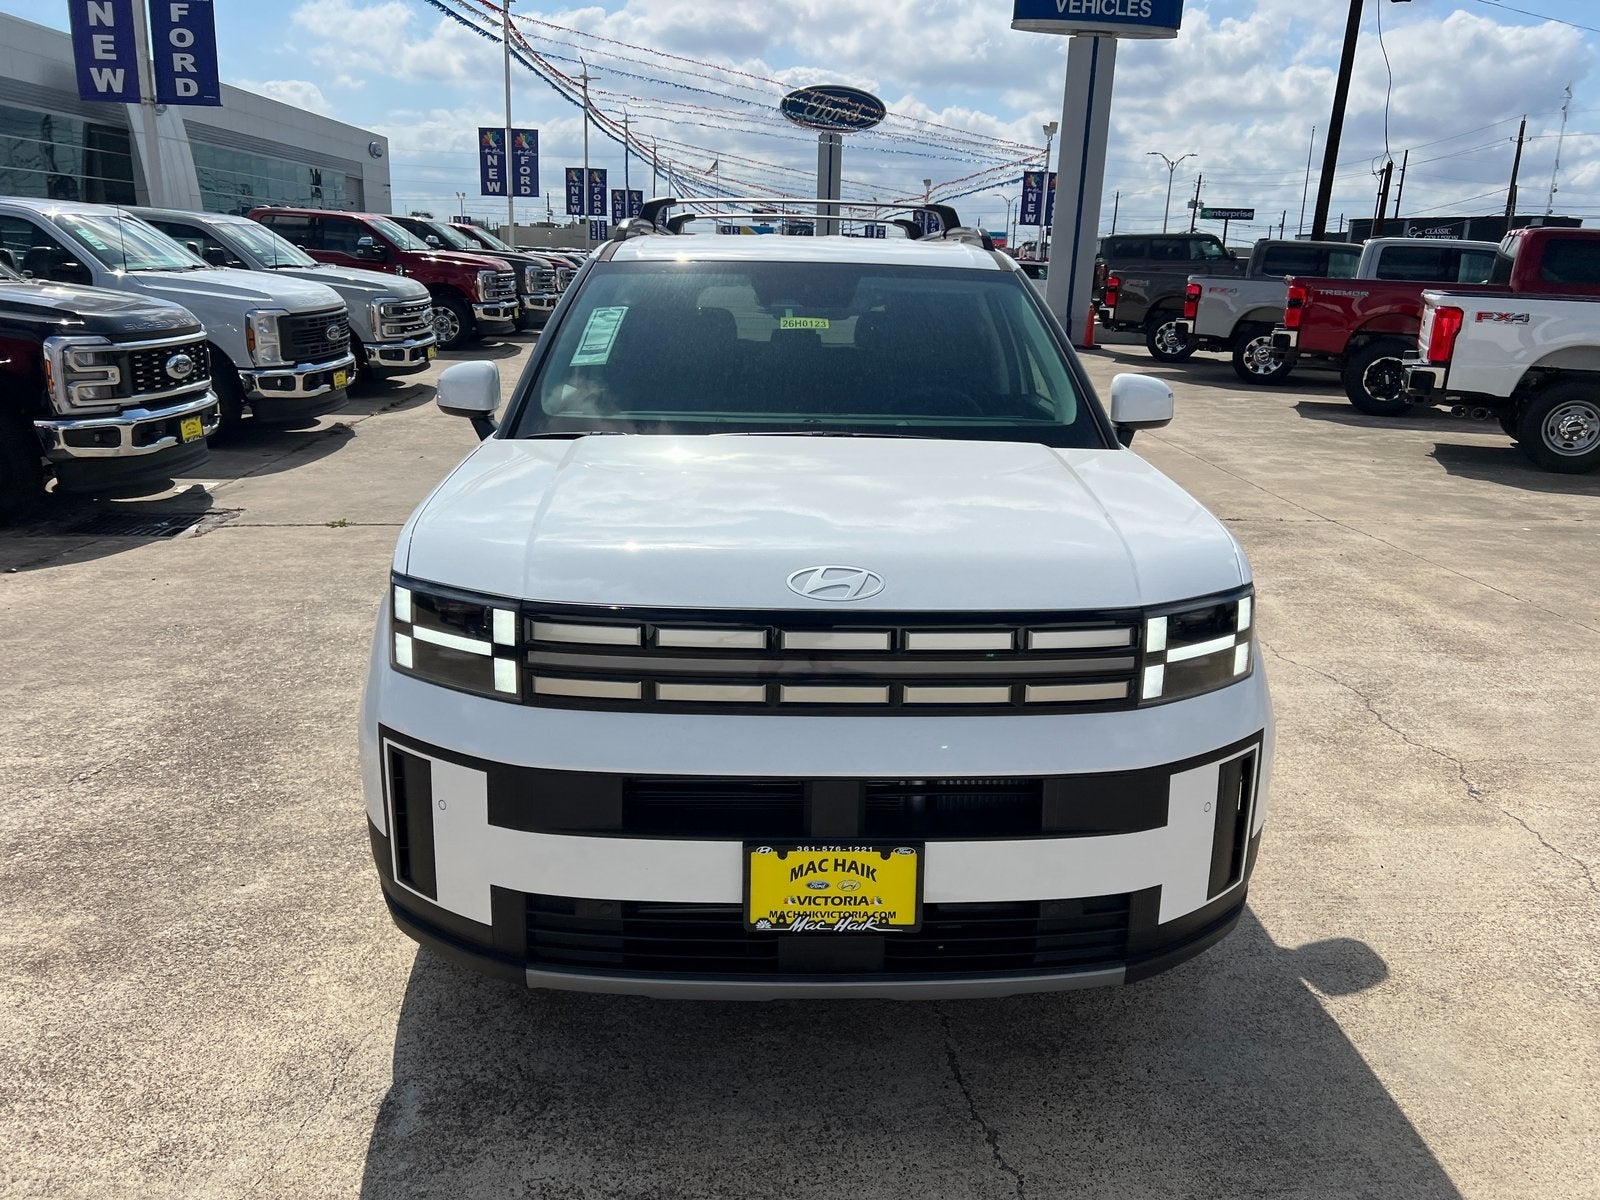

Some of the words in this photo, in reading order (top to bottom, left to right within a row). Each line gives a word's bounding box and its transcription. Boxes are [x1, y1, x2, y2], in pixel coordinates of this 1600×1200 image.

[1056, 0, 1152, 18] VEHICLES
[87, 1, 125, 93] NEW
[169, 3, 199, 97] FORD
[803, 91, 864, 122] Ford
[486, 155, 500, 193] NEW
[520, 156, 531, 194] FORD
[570, 186, 580, 213] NEW
[1025, 193, 1036, 223] NEW
[1204, 210, 1253, 218] enterprise
[1320, 289, 1370, 297] TREMOR
[1475, 311, 1530, 322] FX4
[790, 858, 829, 882] MAC
[833, 858, 877, 882] HAIK
[797, 896, 869, 906] VICTORIA
[789, 916, 826, 932] Mac
[833, 916, 878, 932] Haik
